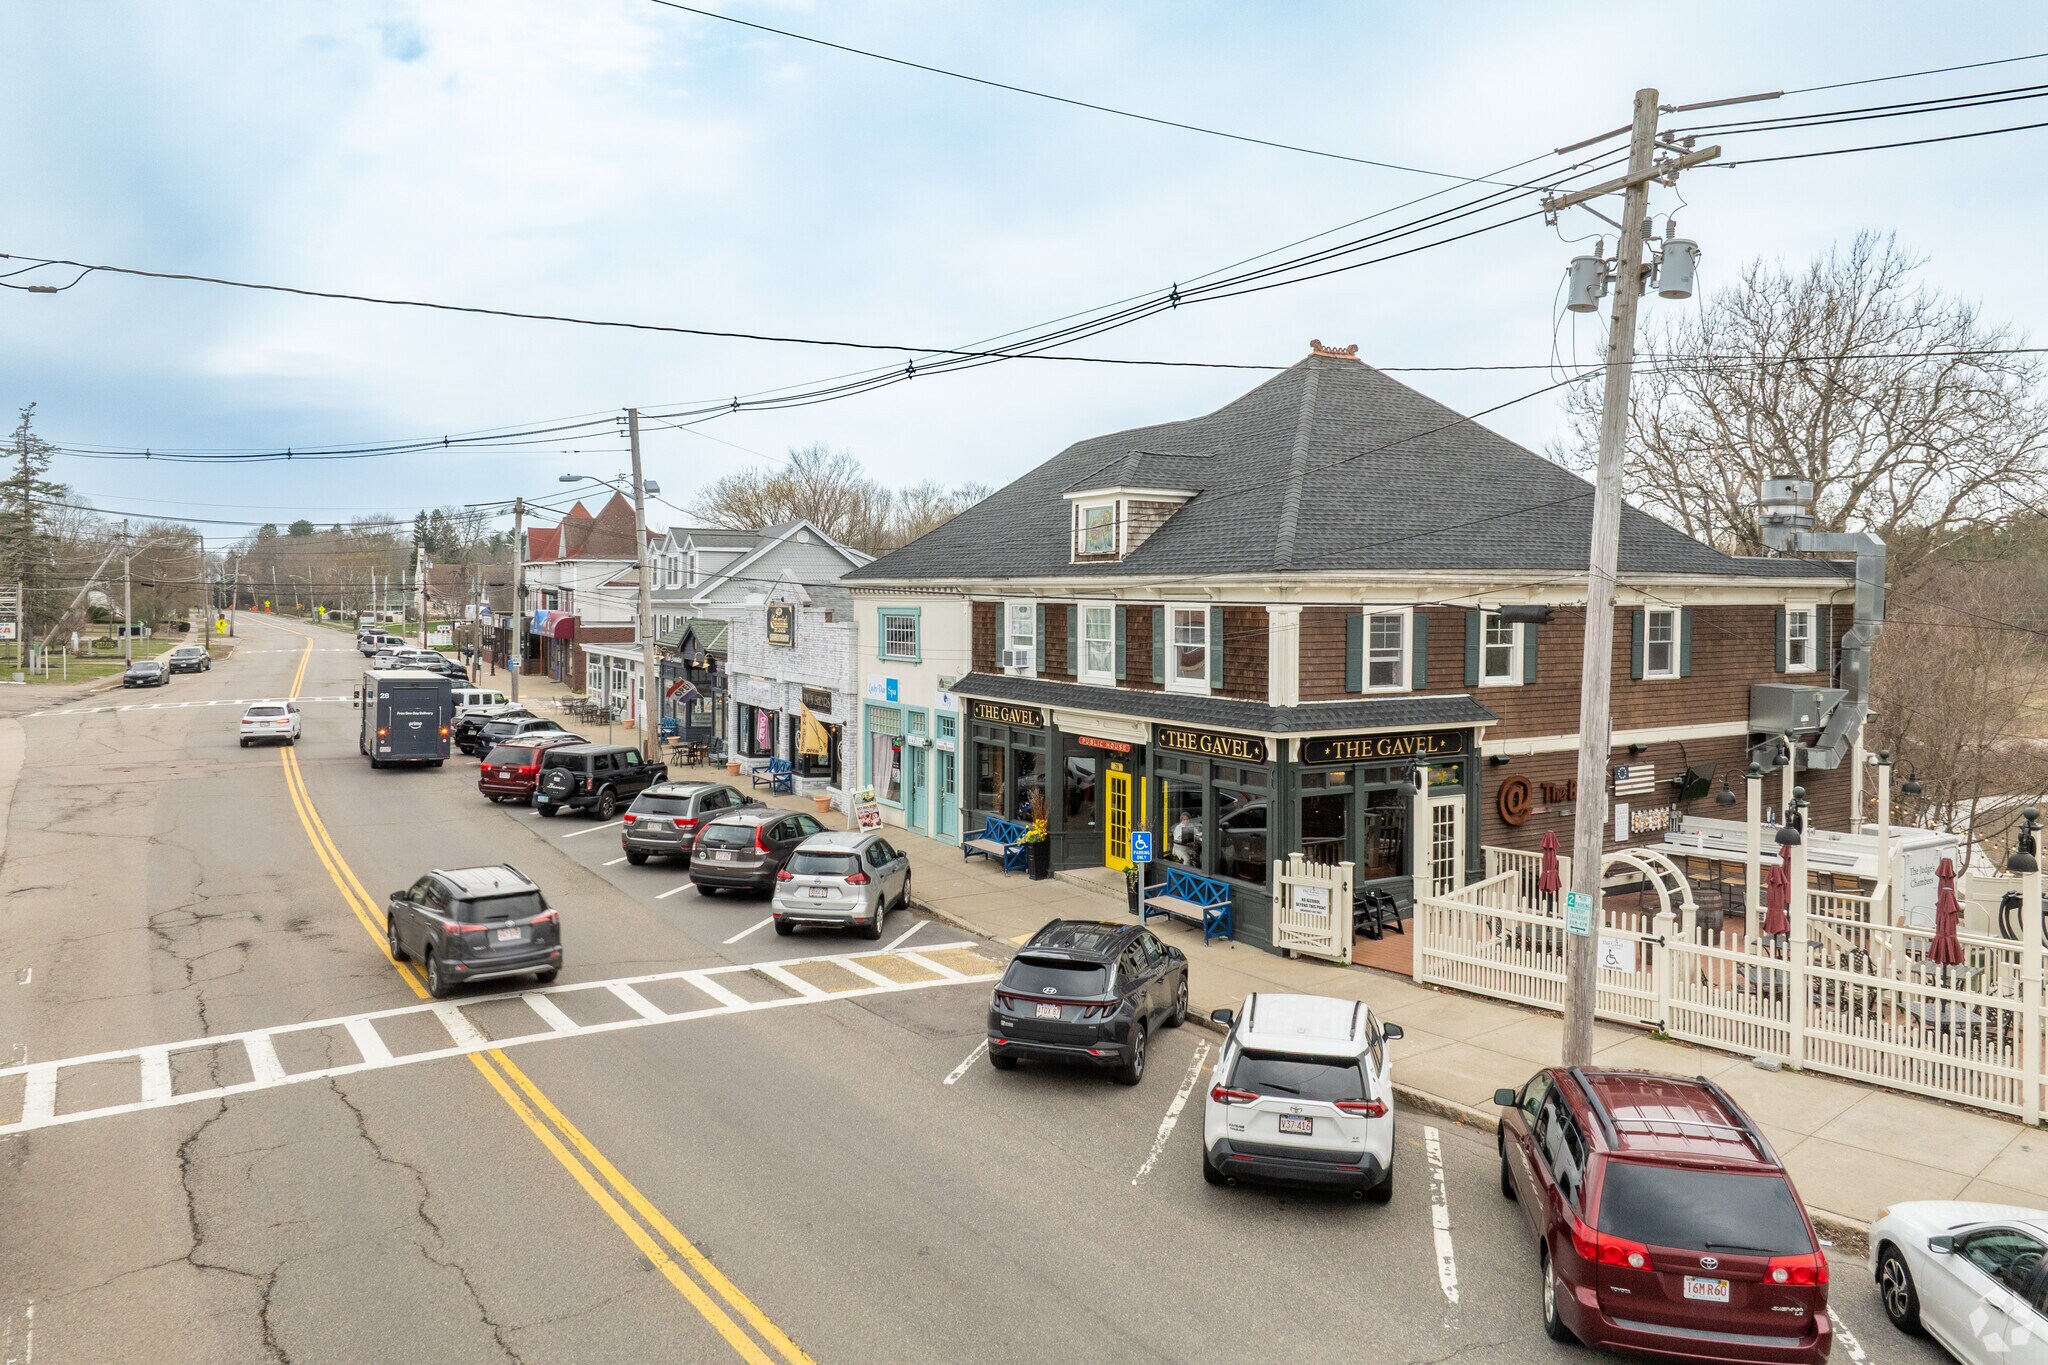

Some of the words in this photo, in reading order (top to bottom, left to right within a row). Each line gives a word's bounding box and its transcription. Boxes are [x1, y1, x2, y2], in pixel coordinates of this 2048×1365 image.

[979, 704, 1000, 719] THE
[1001, 707, 1035, 725] GAVEL
[1082, 737, 1103, 747] PUBLIC
[1105, 740, 1127, 751] HOUSE
[1167, 730, 1198, 750] THE
[1200, 735, 1253, 758] GAVEL
[1333, 740, 1373, 759] THE
[1377, 736, 1438, 756] GAVEL
[1541, 781, 1568, 804] The
[1909, 865, 1919, 876] The
[1910, 876, 1934, 888] Chambers
[1568, 894, 1575, 905] 2
[1610, 1285, 1632, 1295] TOYOTA
